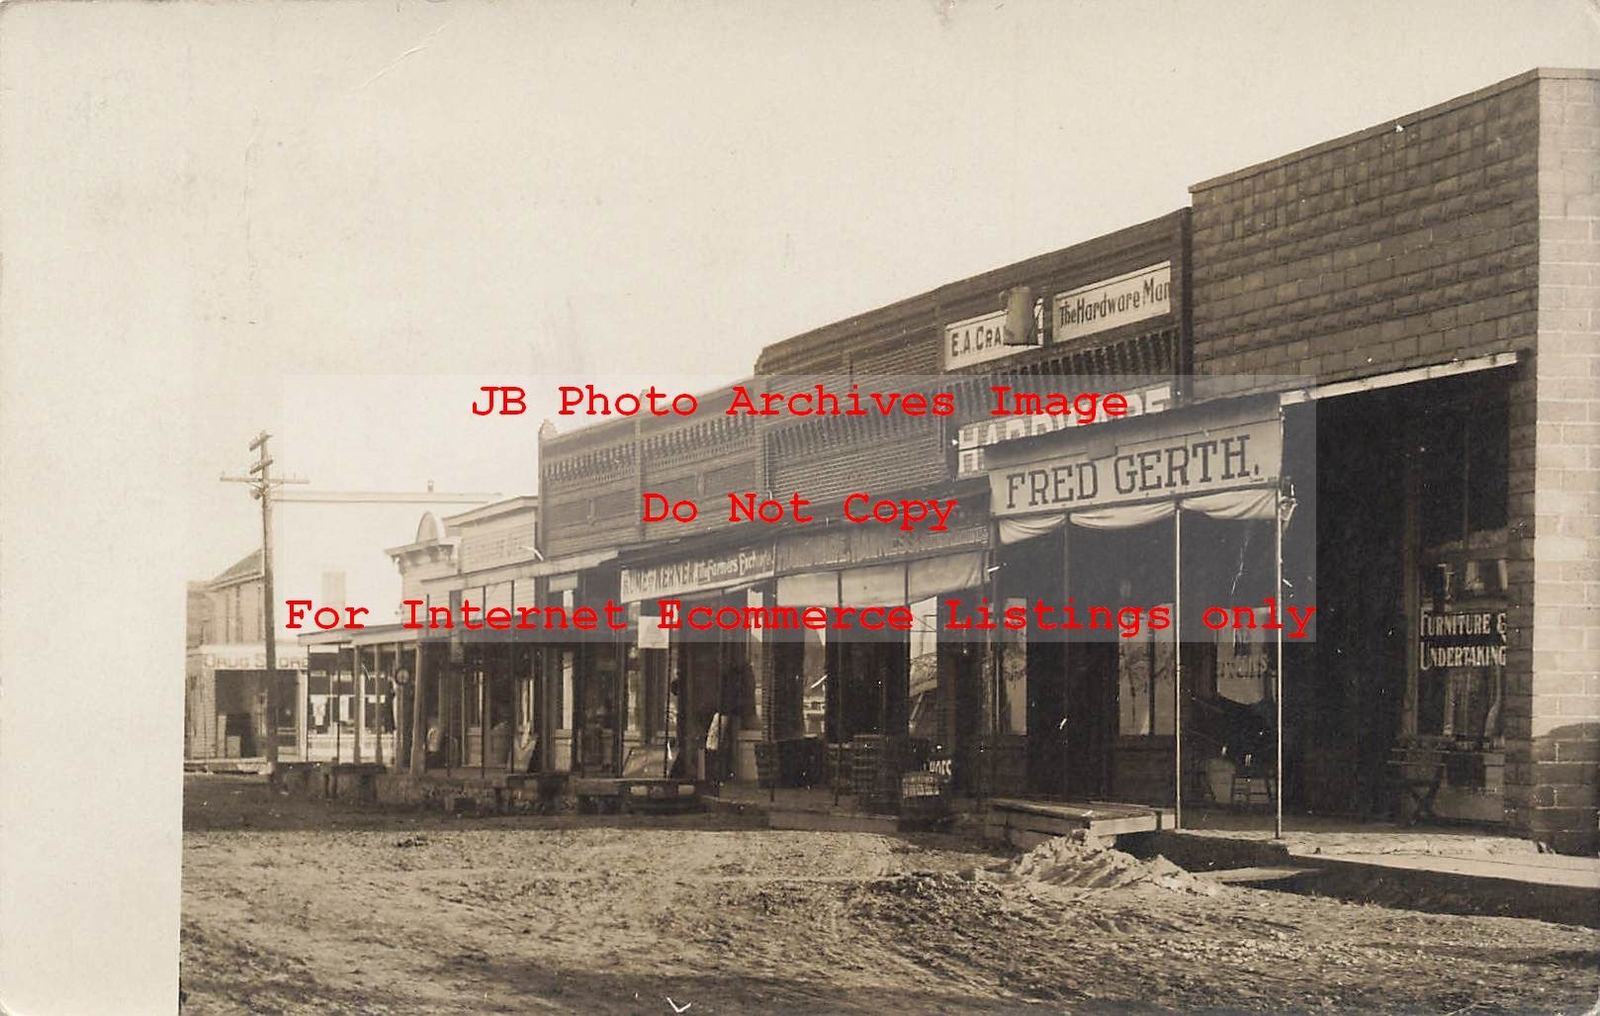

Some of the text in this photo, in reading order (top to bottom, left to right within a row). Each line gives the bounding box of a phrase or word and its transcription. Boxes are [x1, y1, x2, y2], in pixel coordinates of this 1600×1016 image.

[1059, 301, 1076, 329] The
[1076, 291, 1140, 325] Hardware
[1005, 461, 1099, 509] FRED
[1420, 607, 1491, 636] FURNITURE
[1420, 641, 1507, 671] UNDERTAKING
